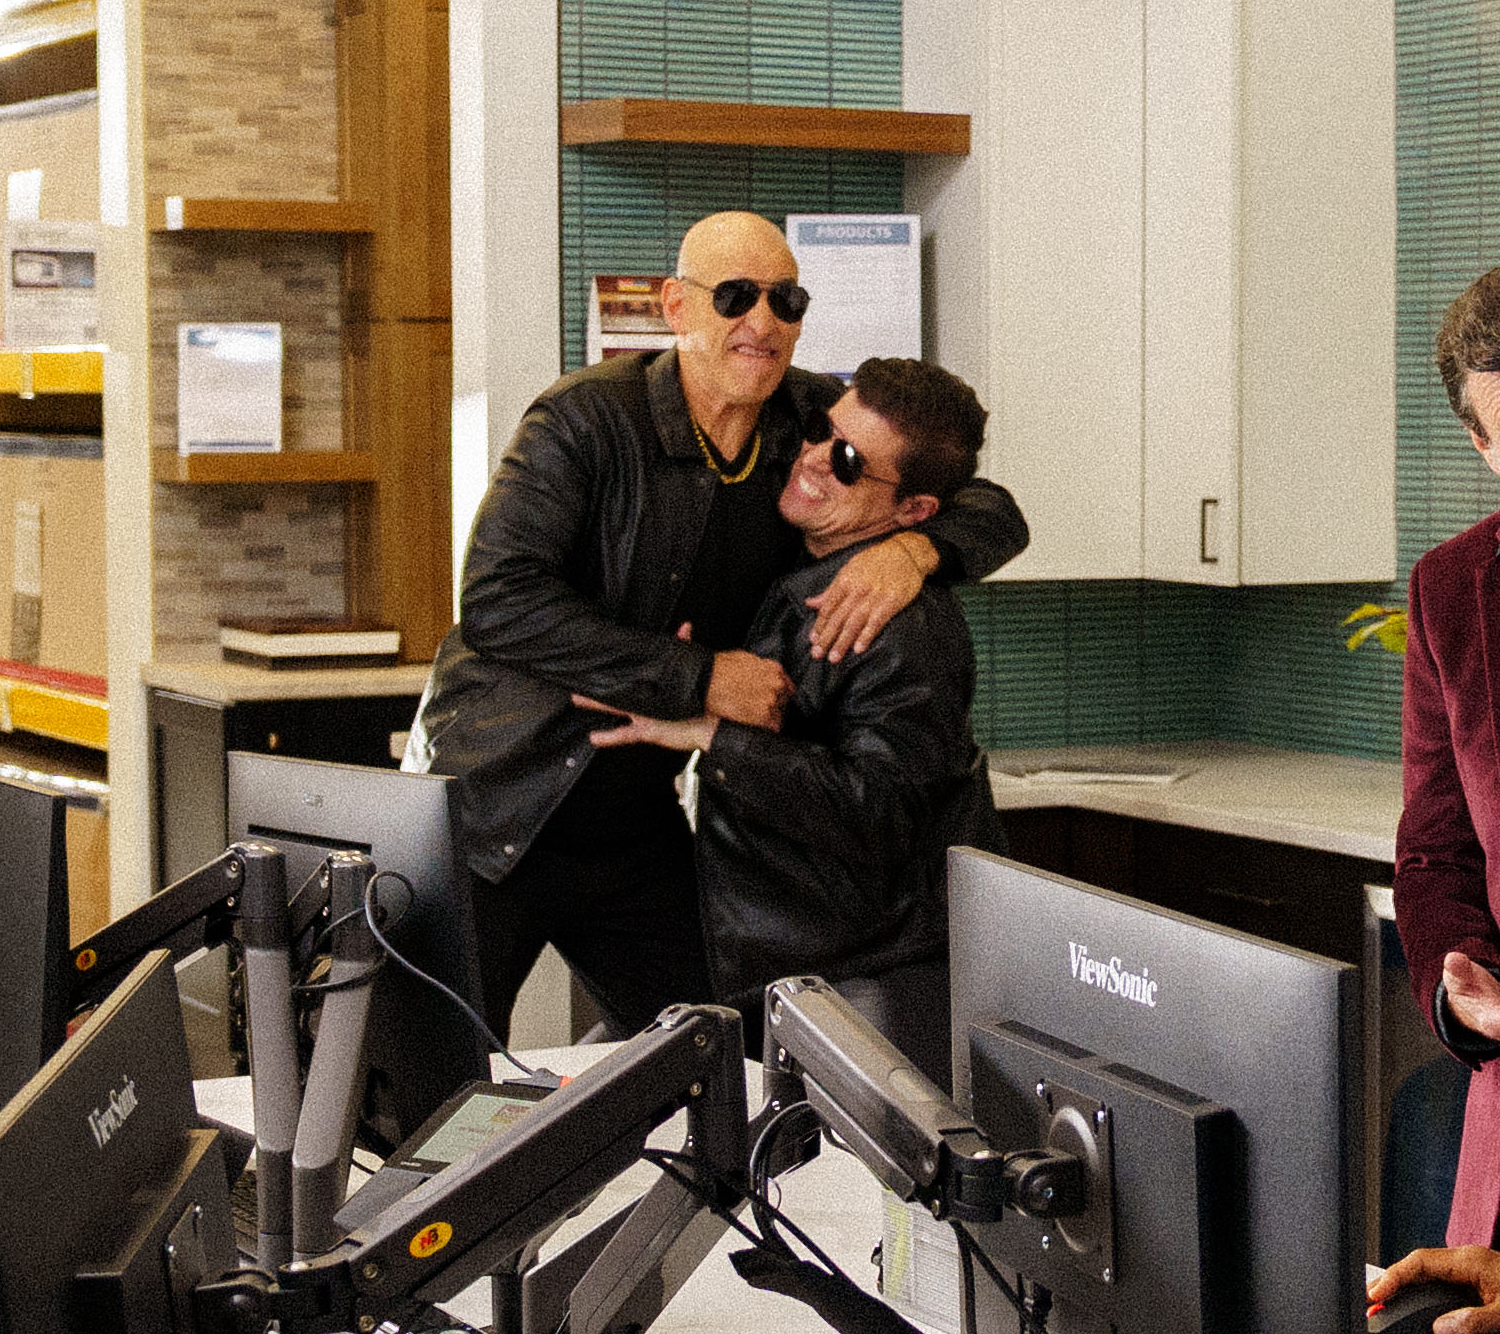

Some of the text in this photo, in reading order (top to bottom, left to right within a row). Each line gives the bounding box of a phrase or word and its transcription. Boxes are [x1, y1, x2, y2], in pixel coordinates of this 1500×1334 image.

[815, 224, 893, 239] PRODUCTS
[1067, 940, 1159, 1008] ViewSonic
[87, 1073, 140, 1150] ViewSonic
